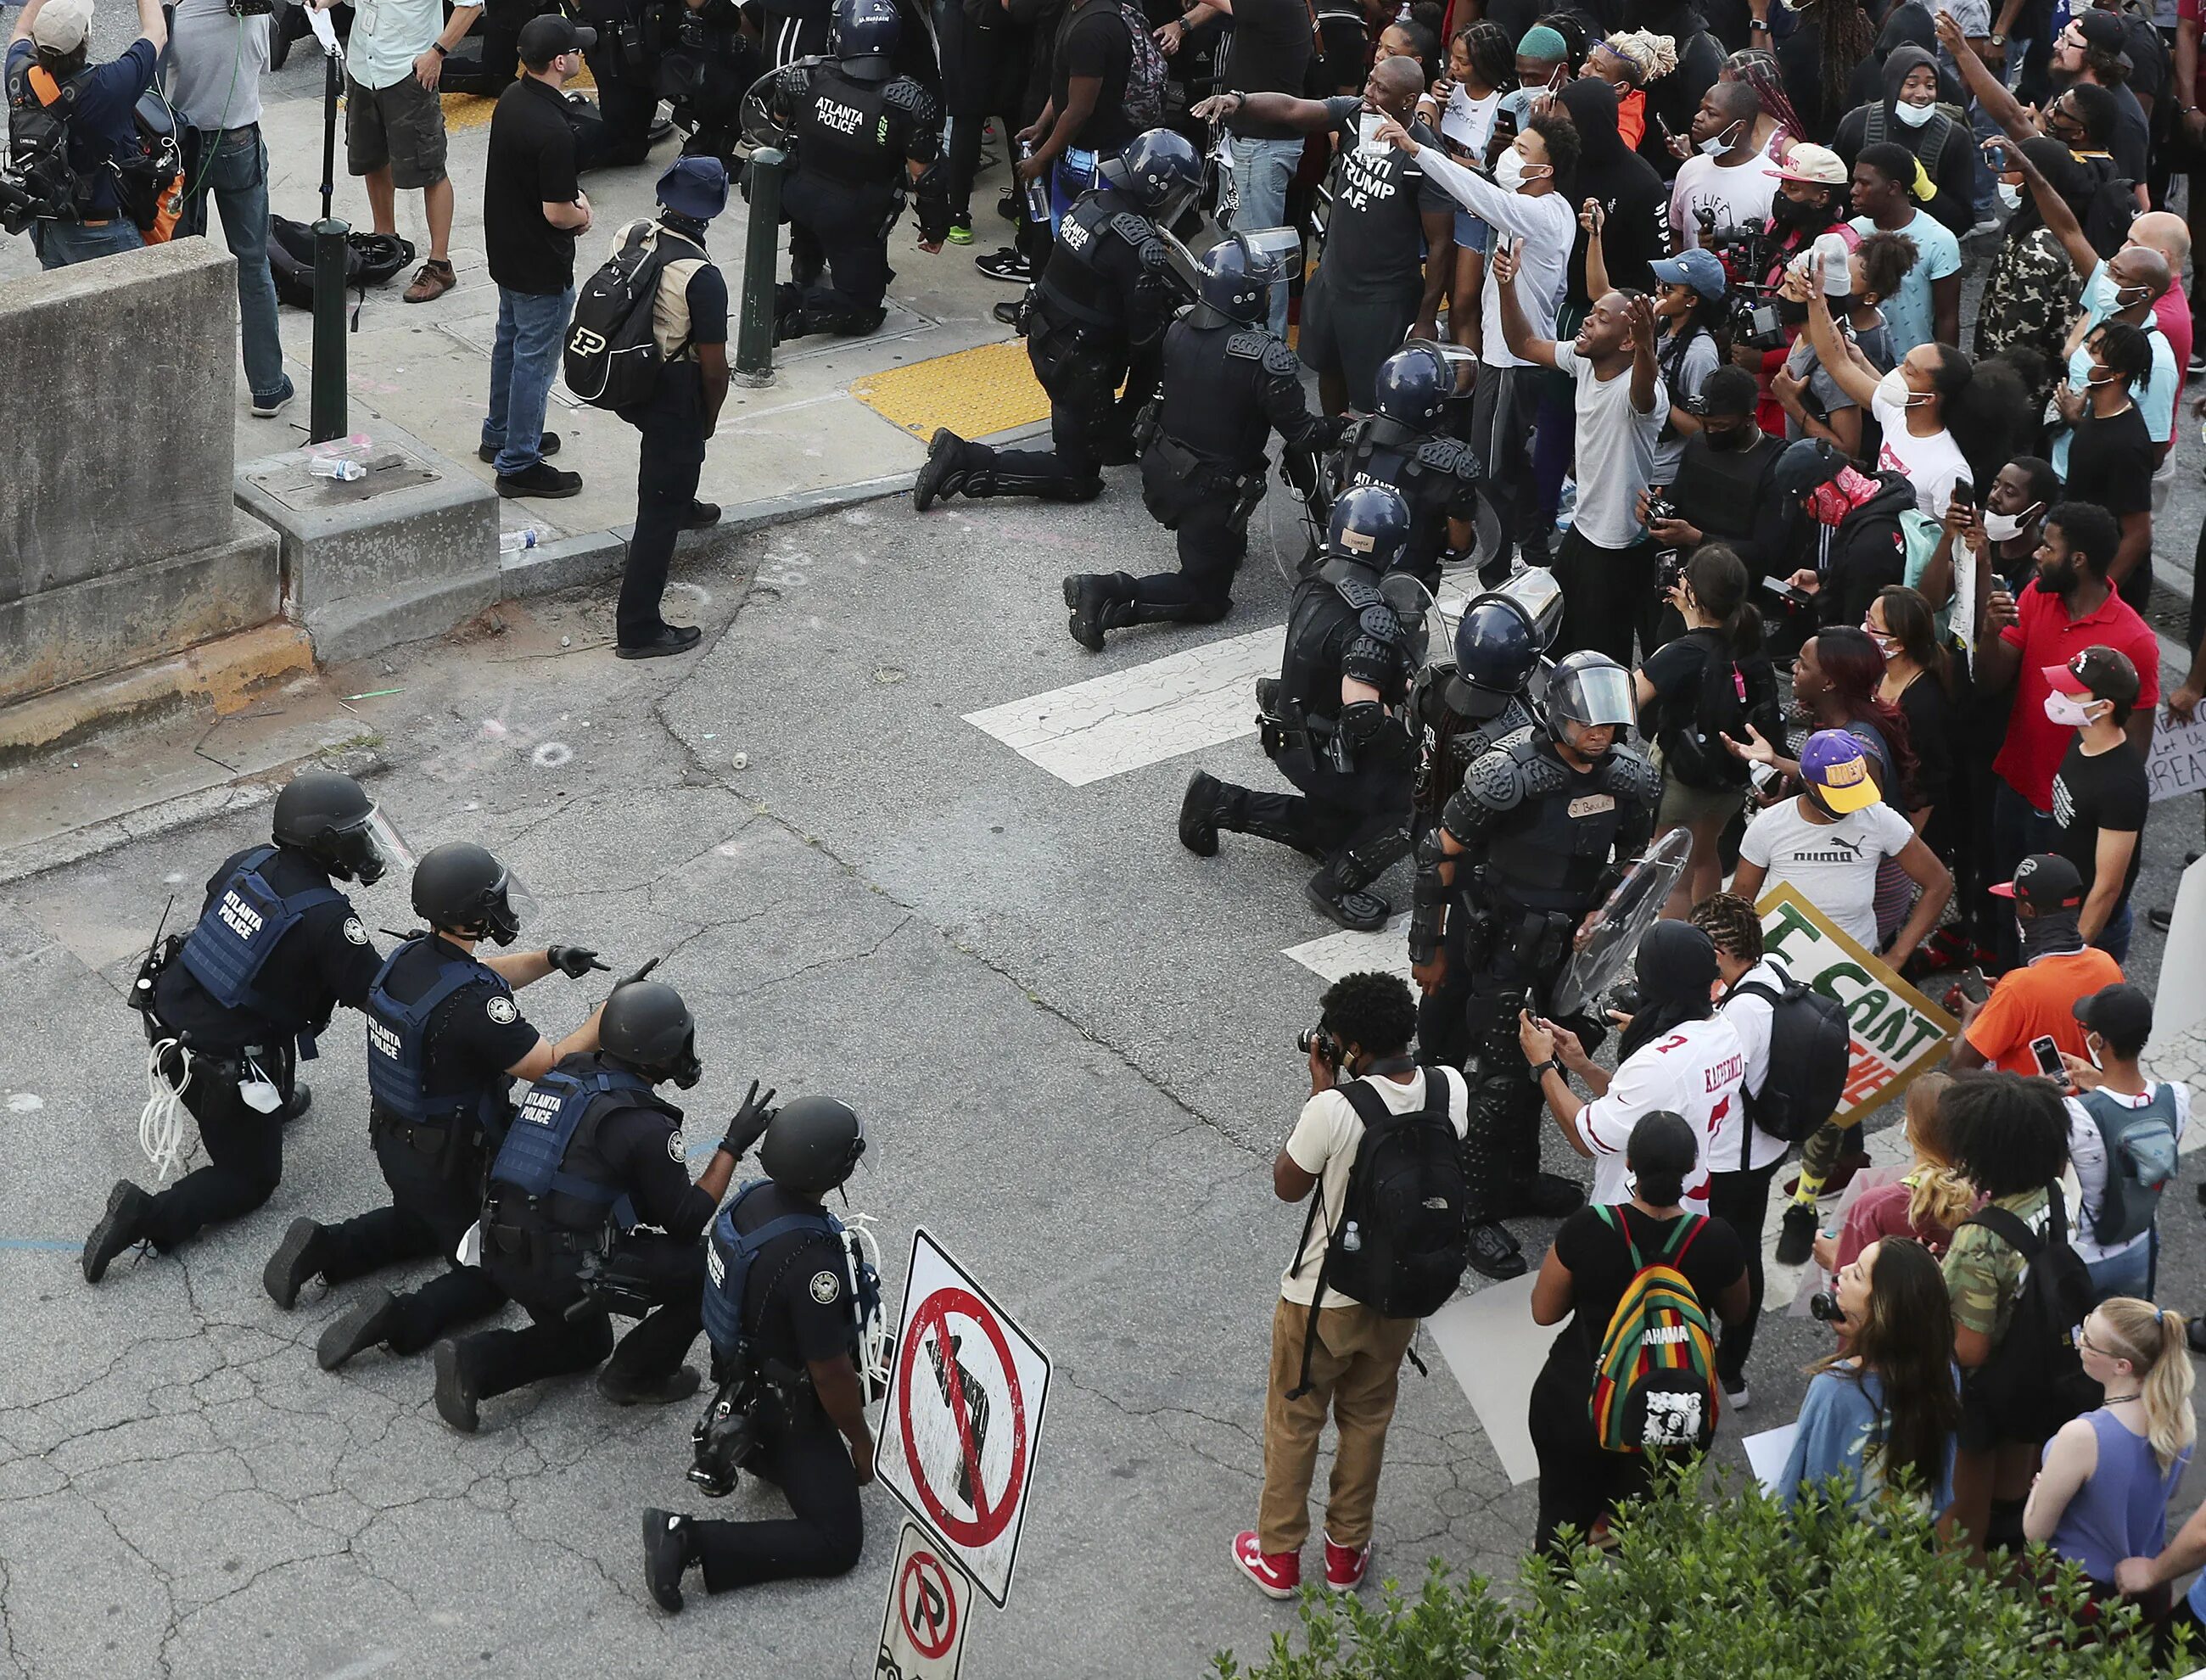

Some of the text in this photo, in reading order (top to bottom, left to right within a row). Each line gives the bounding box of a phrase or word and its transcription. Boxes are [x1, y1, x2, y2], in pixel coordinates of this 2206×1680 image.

[815, 96, 864, 126] ATLANTA
[817, 110, 856, 135] POLICE
[1341, 153, 1396, 199] TRUMP
[1341, 186, 1368, 212] AF.
[1060, 222, 1082, 251] POLICE
[1062, 214, 1089, 244] ATLANTA
[2153, 738, 2176, 756] Let
[217, 904, 253, 940] POLICE
[222, 889, 263, 932] ATLANTA
[1763, 902, 1822, 966] I
[367, 1014, 401, 1049] ATLANTA
[370, 1028, 398, 1060] POLICE
[520, 1106, 552, 1125] POLICE
[524, 1091, 562, 1112] ATLANTA
